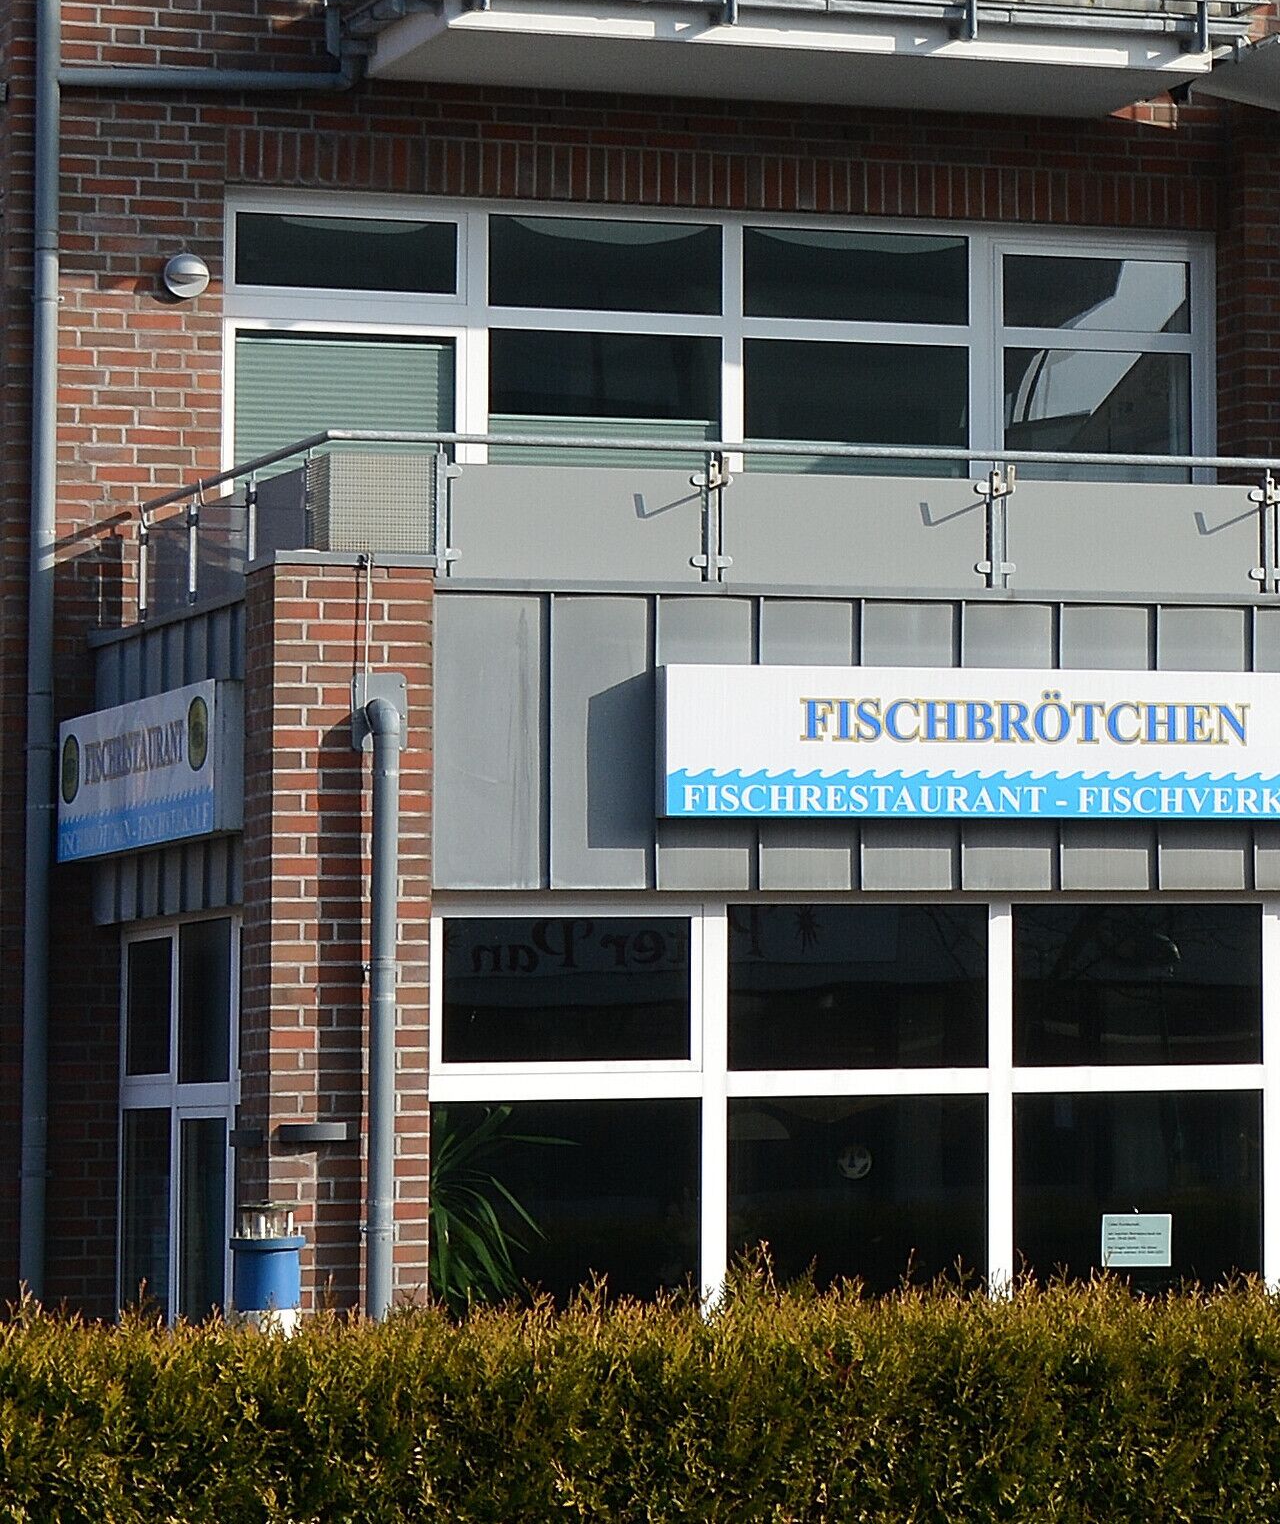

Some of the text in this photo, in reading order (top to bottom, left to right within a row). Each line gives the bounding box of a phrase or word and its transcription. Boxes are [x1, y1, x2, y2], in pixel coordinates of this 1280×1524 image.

[799, 689, 1250, 746] FISCHBRÖTCHEN
[84, 719, 184, 785] FISCHRESTAURANT
[682, 784, 1047, 814] FISCHRESTAURANT
